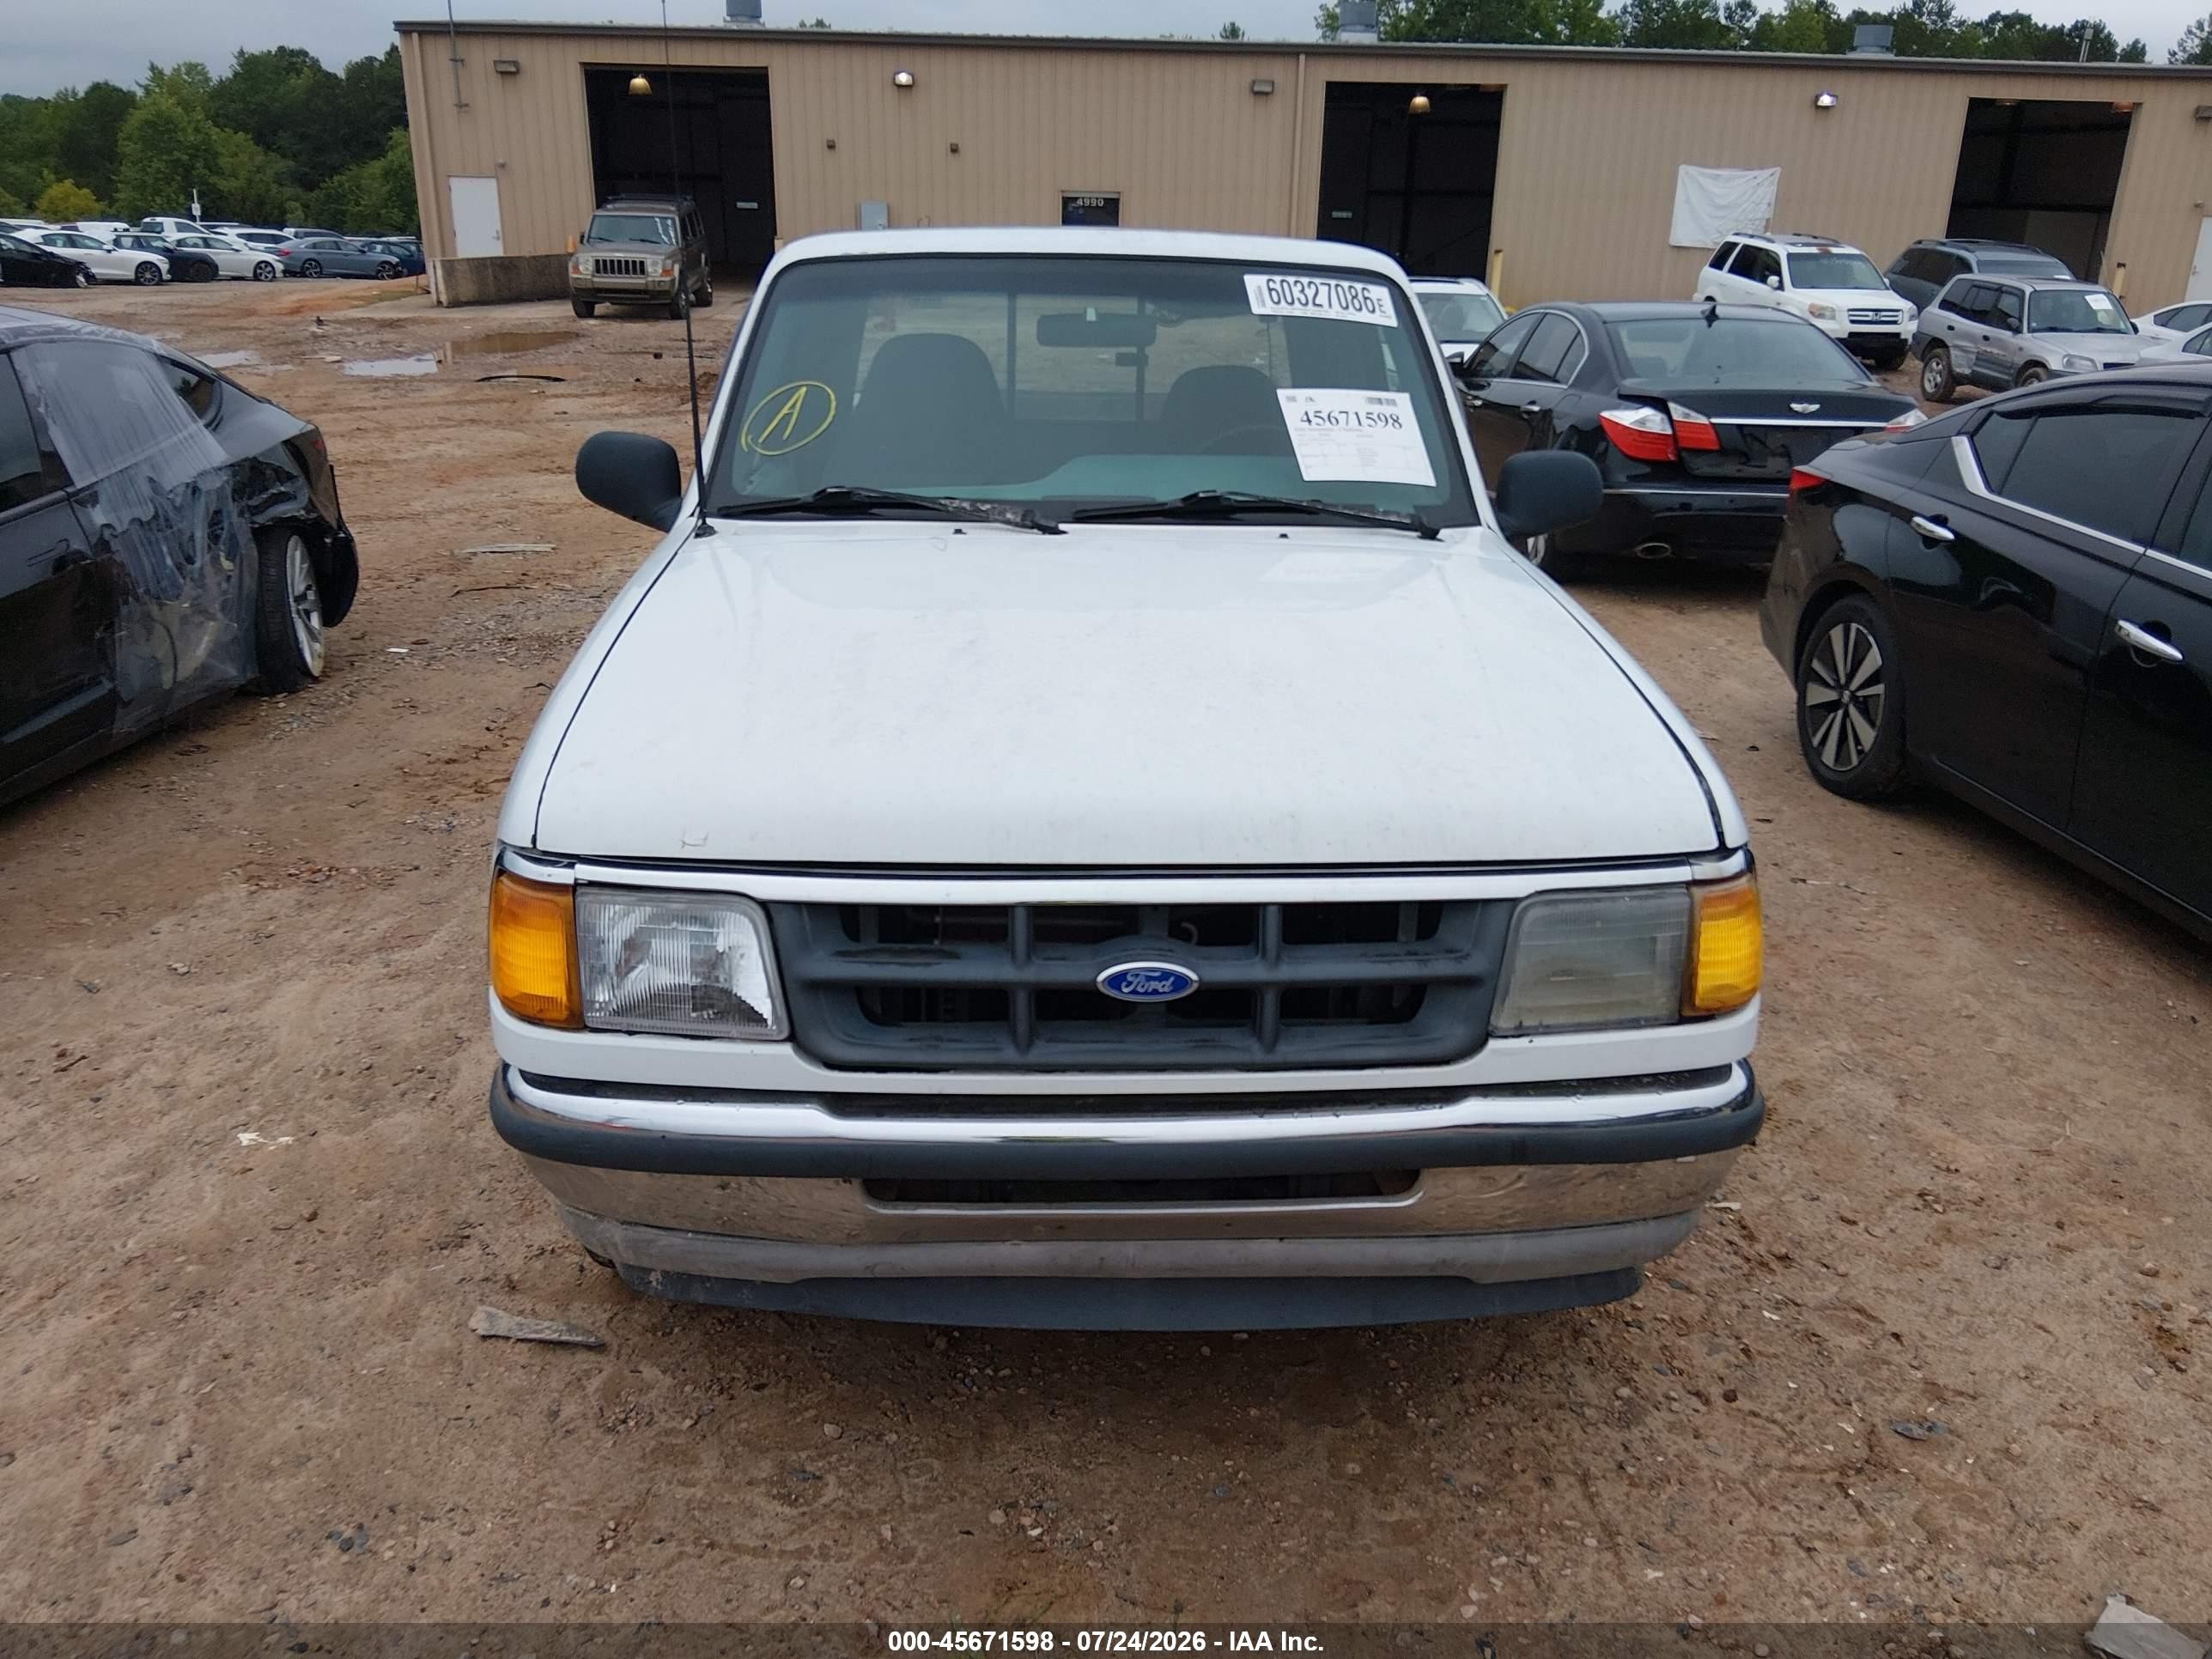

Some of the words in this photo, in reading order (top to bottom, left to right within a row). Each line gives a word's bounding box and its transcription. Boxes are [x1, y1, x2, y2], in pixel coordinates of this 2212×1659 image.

[1076, 198, 1104, 207] 4990
[1266, 278, 1376, 313] 60327086
[1376, 297, 1388, 314] E
[758, 386, 807, 443] A
[1300, 410, 1402, 429] 45671598
[1121, 970, 1176, 993] Ford
